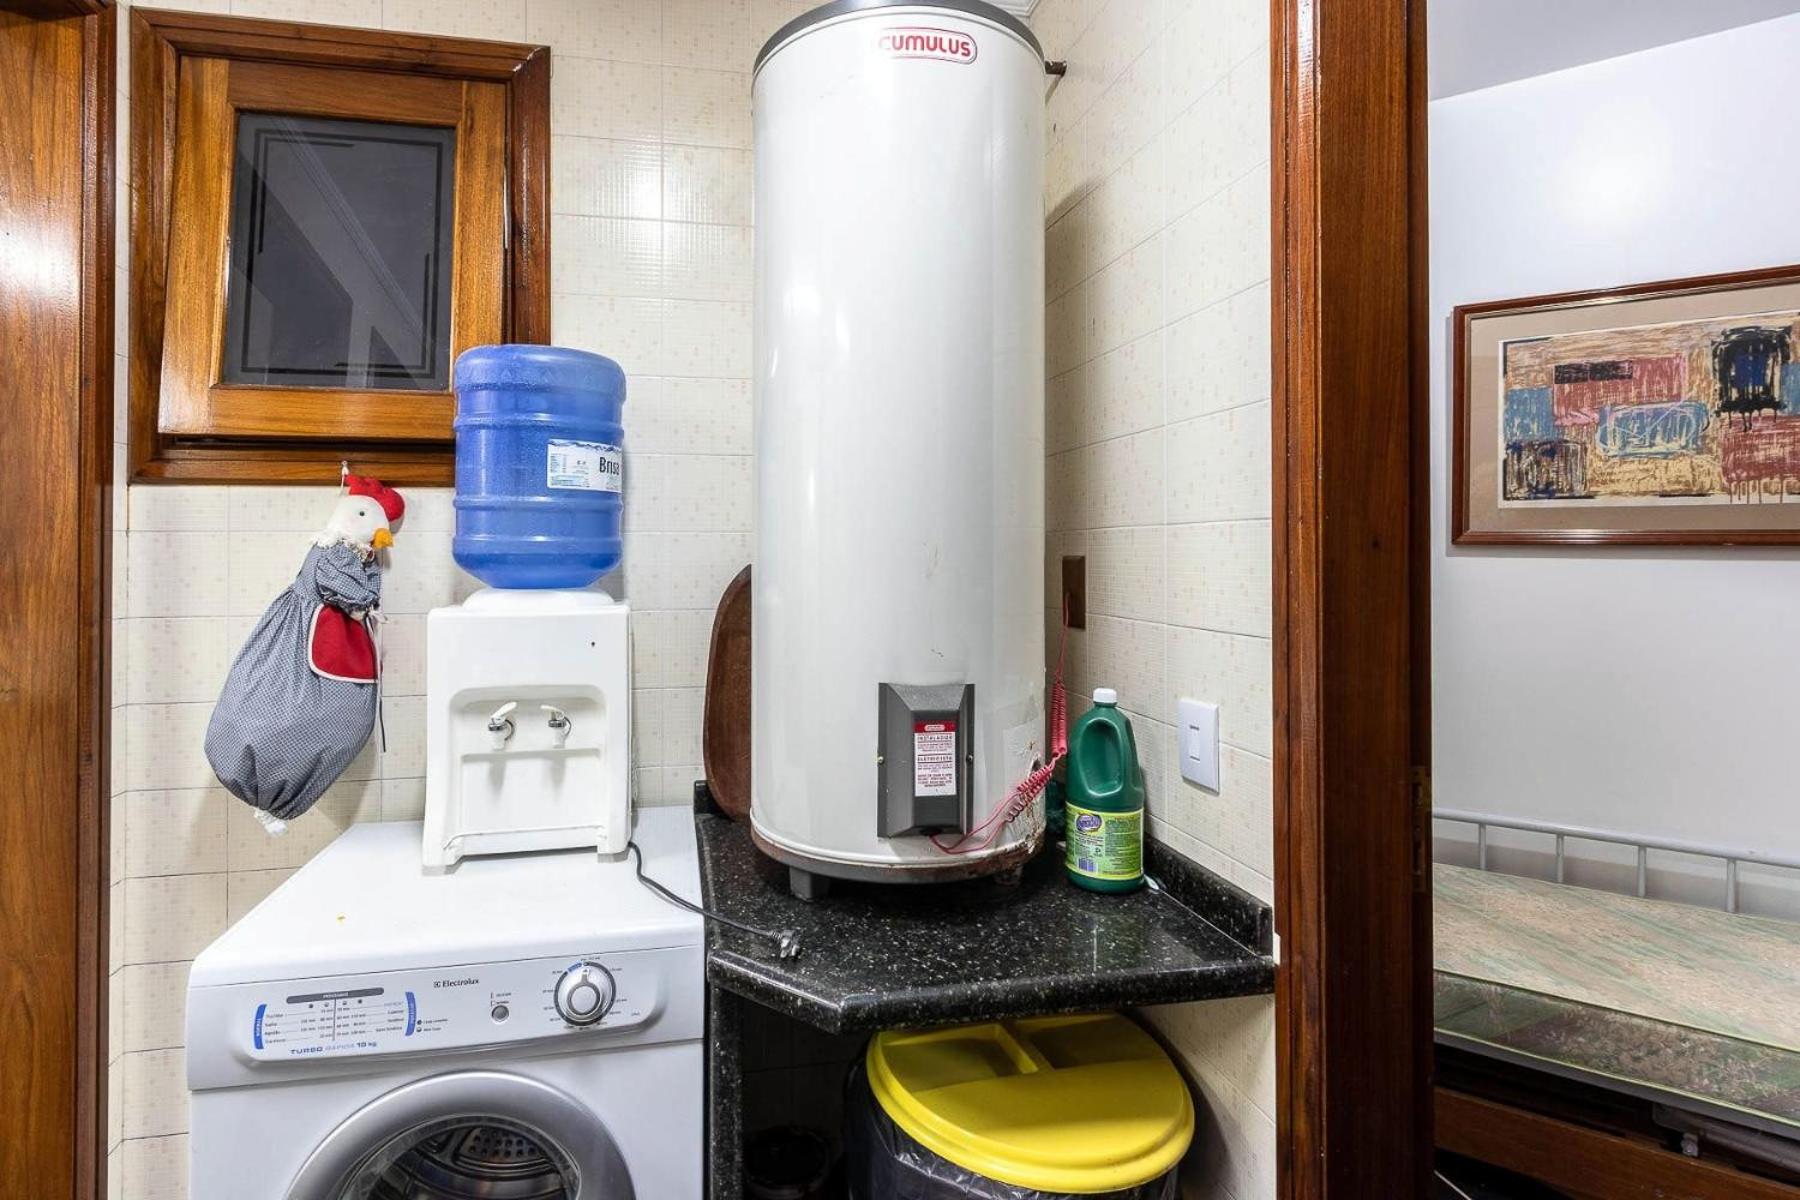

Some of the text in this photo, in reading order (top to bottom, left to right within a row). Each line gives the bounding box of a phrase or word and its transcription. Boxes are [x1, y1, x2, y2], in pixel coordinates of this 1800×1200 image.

[878, 35, 971, 57] CUMULUS
[442, 977, 479, 988] Electrolux
[290, 1046, 324, 1055] TURBO
